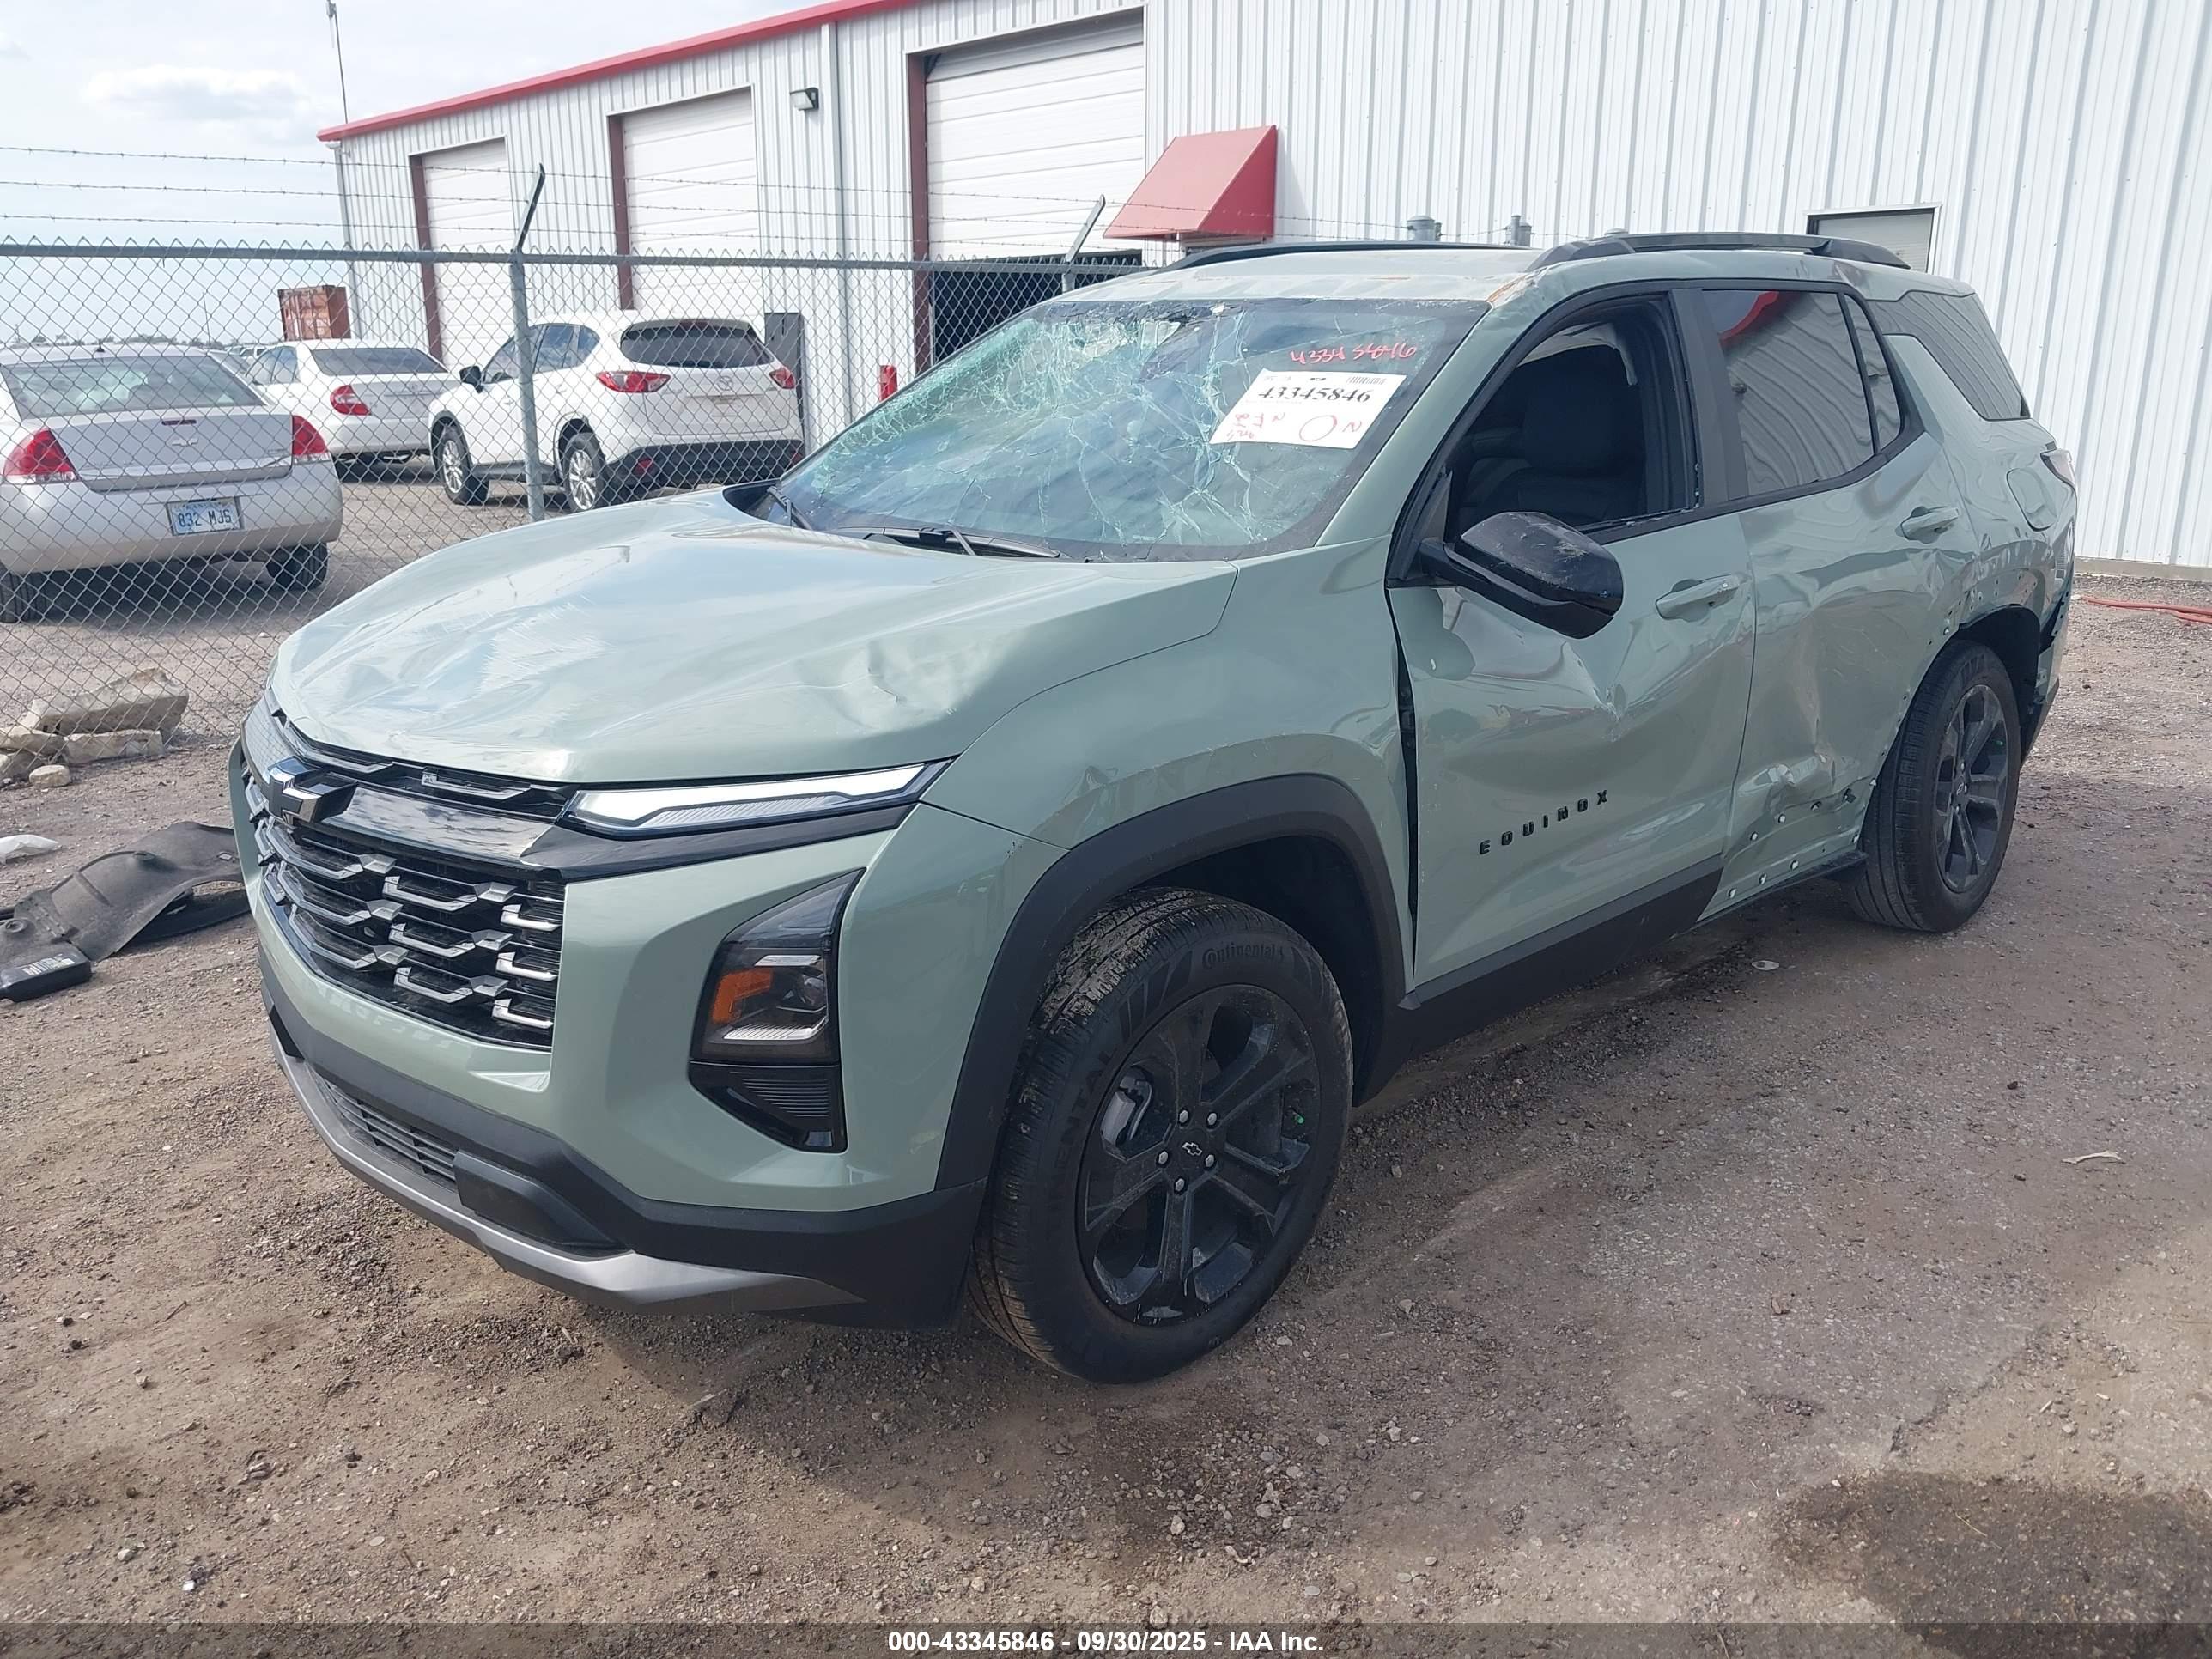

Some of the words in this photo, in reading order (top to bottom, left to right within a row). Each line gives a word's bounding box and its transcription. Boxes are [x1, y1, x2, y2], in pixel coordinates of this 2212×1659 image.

[1258, 386, 1375, 403] 43345846
[178, 511, 202, 528] 832
[1479, 789, 1608, 855] EQUINOX
